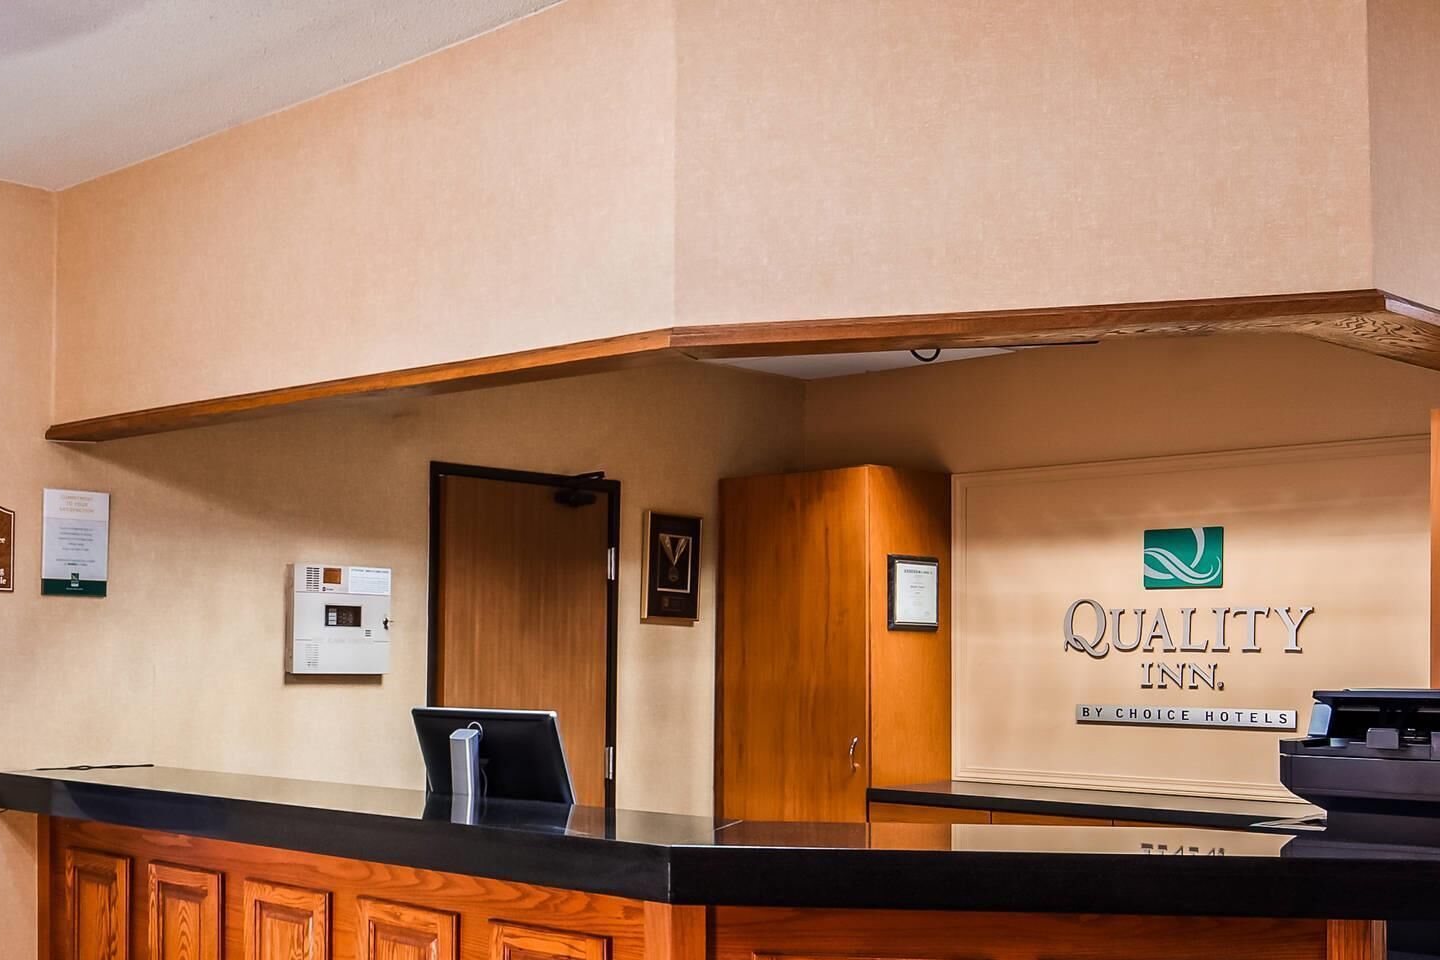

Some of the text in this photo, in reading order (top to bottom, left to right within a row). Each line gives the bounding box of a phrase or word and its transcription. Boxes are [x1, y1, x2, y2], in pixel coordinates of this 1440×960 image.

[1063, 598, 1314, 659] QUALITY
[1082, 707, 1288, 724] BY CHOICE HOTELS
